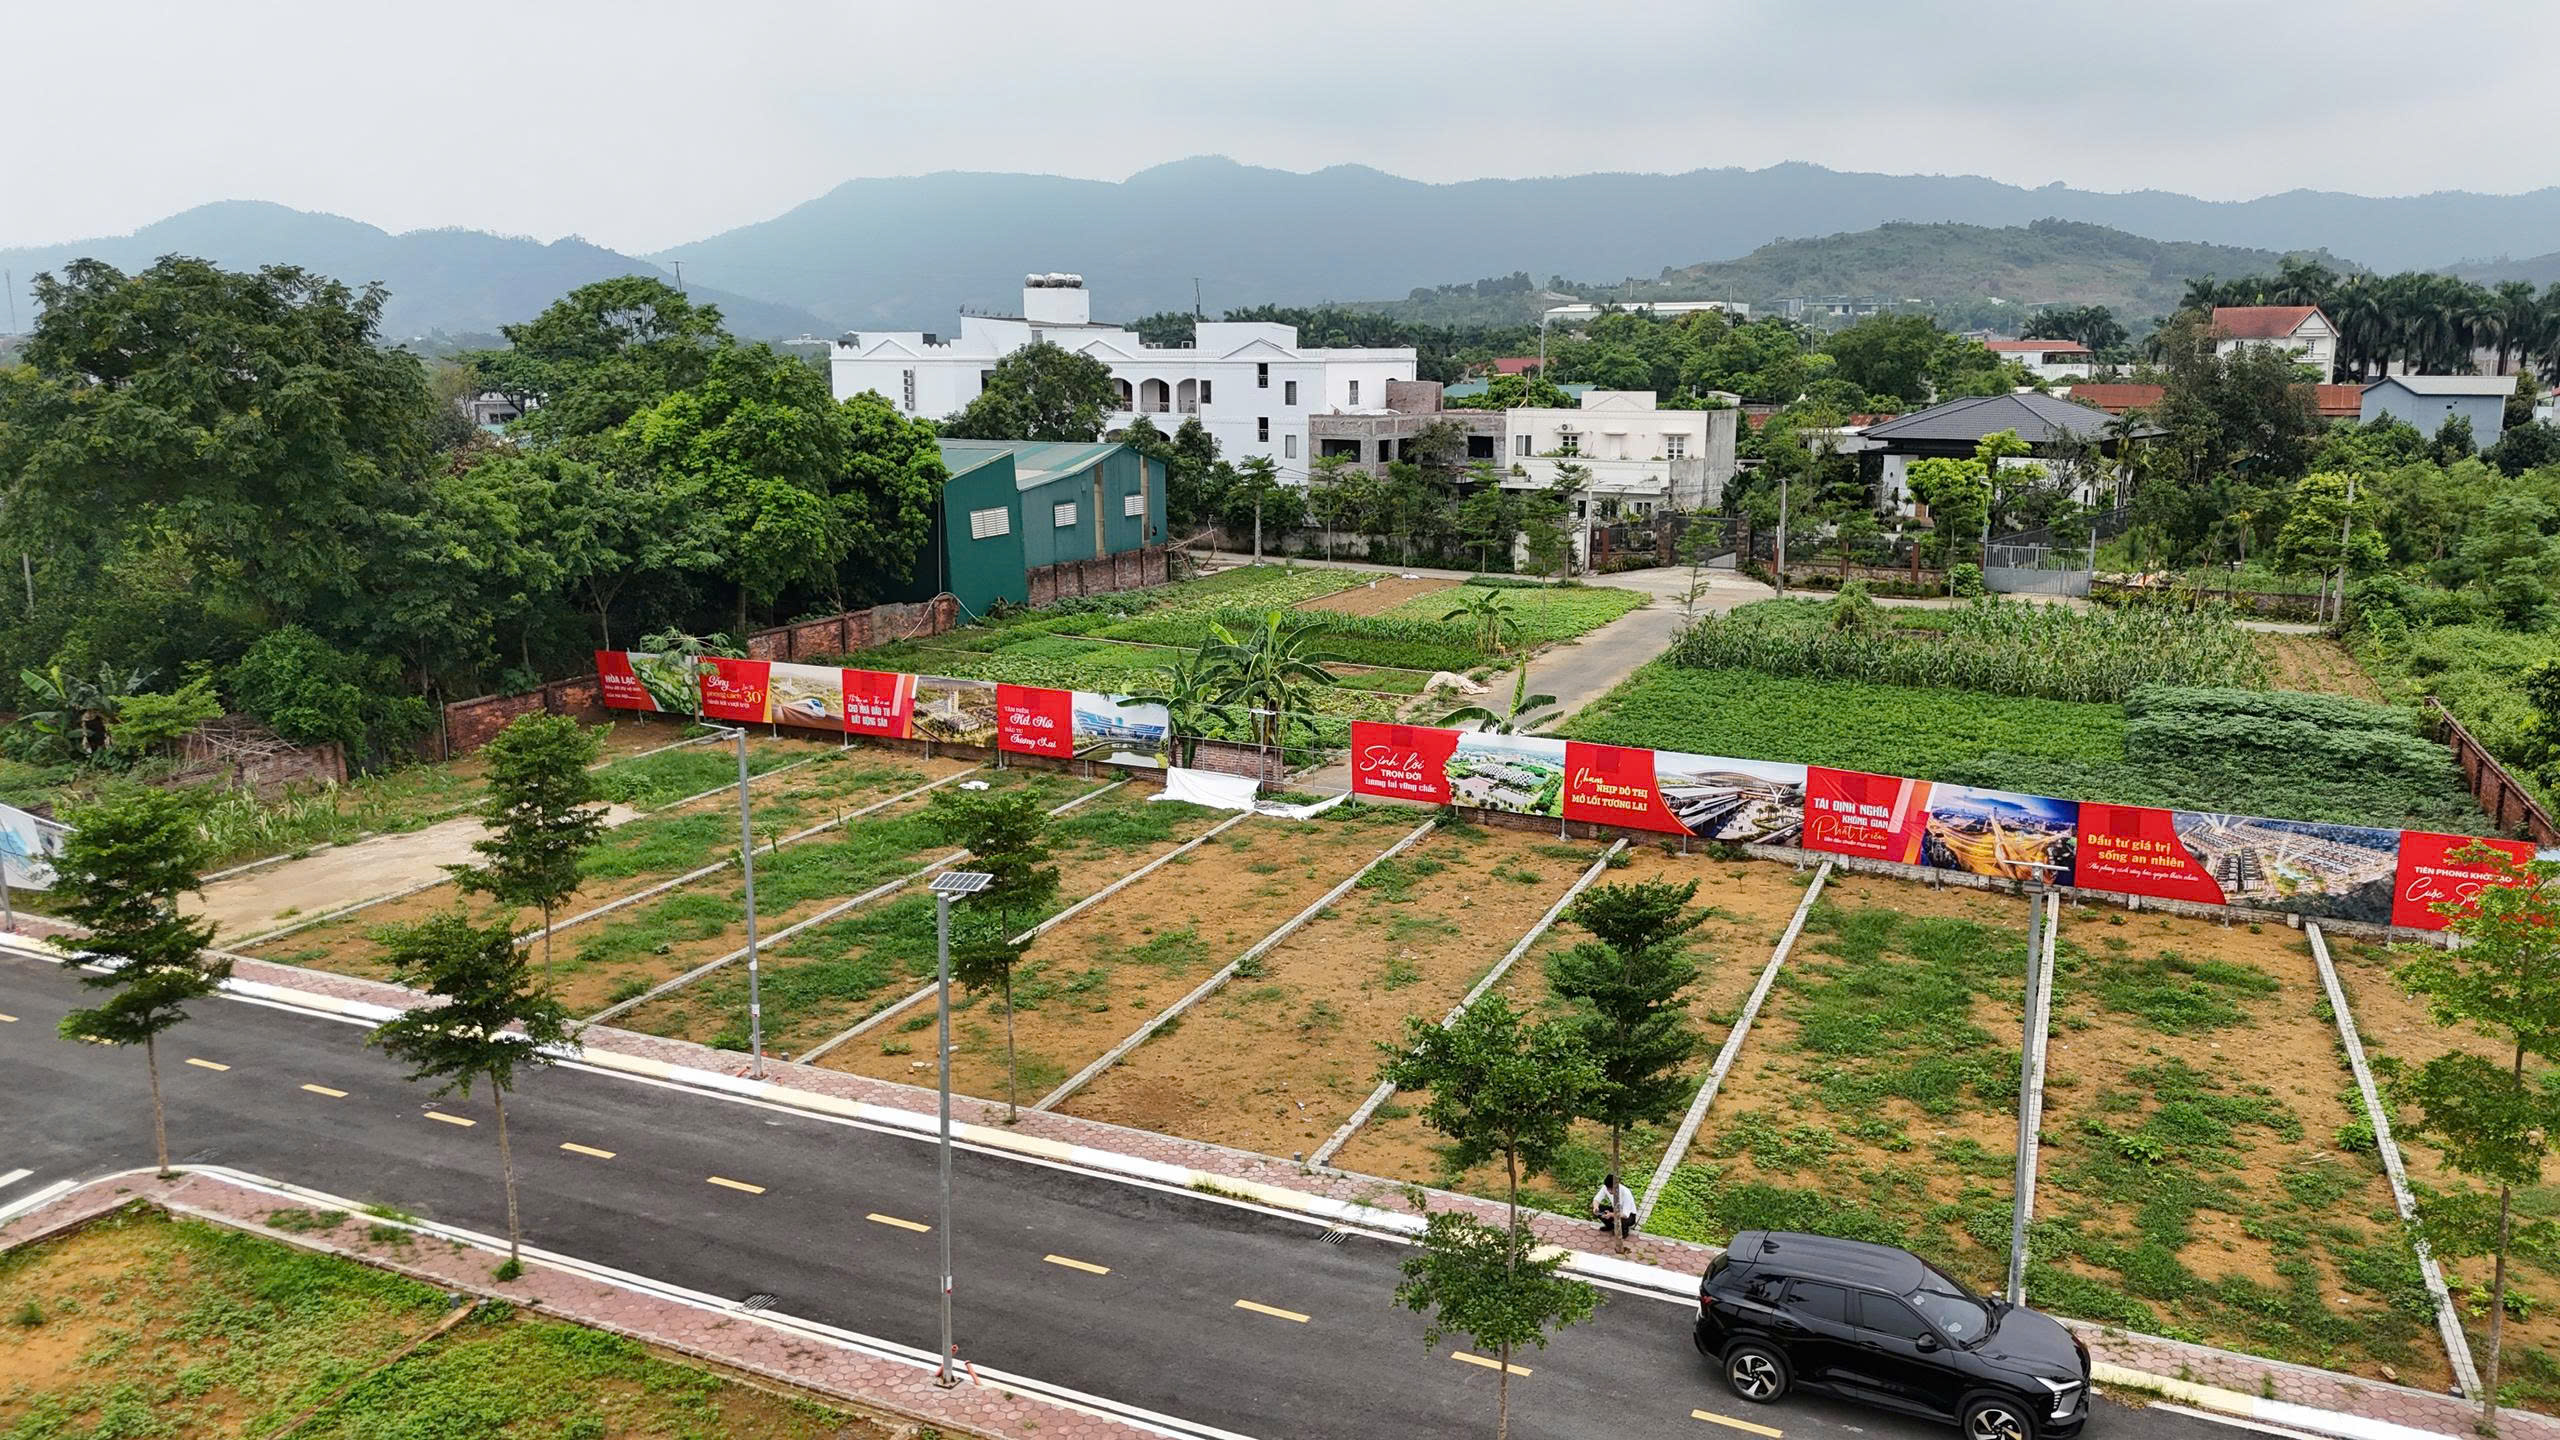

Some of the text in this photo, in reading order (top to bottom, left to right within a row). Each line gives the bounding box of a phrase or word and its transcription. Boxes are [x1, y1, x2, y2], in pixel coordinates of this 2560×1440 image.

[1360, 745, 1425, 771] Sinh lời
[1381, 769, 1422, 781] TRỌN ĐỜI
[1364, 776, 1437, 793] tương lai vững chắc
[1596, 784, 1649, 800] NHỊP ĐÔ THỊ
[1586, 794, 1601, 806] LỐI
[1601, 797, 1631, 809] TƯƠNG
[1631, 801, 1648, 812] LAI
[1813, 797, 1890, 818] TÁI ĐỊNH NGHĨA
[1811, 815, 1857, 841] Phát
[1842, 814, 1889, 829] KHÔNG GIAN
[2088, 834, 2171, 855] Đầu tư giá trị
[2098, 849, 2185, 868] sống an nhiên
[2414, 866, 2513, 884] TIÊN PHONG KHỞ ẠO
[2406, 876, 2445, 902] Cuộc
